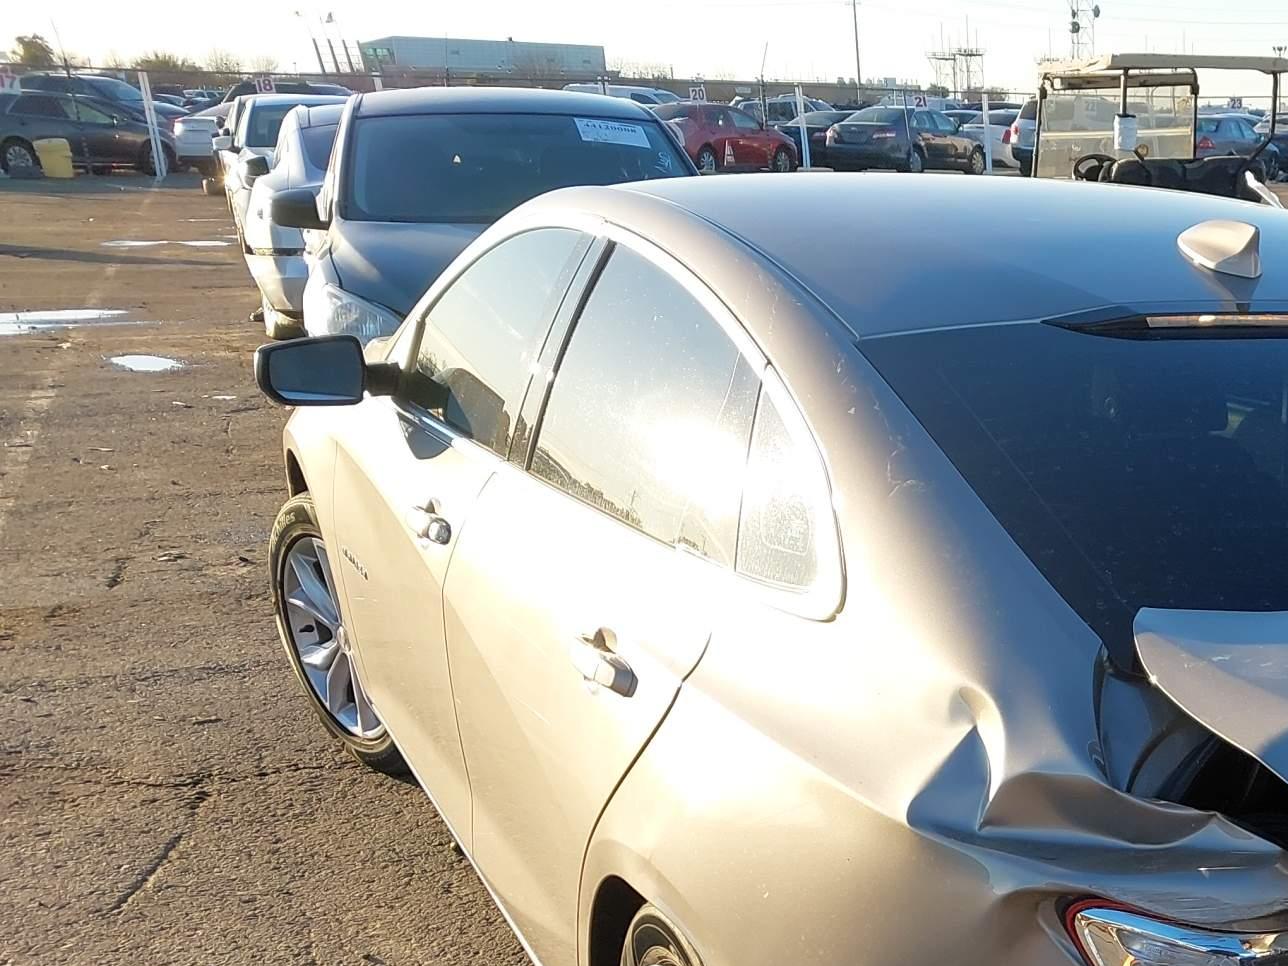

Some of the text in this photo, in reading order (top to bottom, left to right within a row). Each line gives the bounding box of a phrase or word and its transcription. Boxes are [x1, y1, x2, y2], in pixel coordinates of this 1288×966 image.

[256, 79, 273, 92] 18
[691, 88, 705, 101] 20
[915, 96, 928, 108] 21
